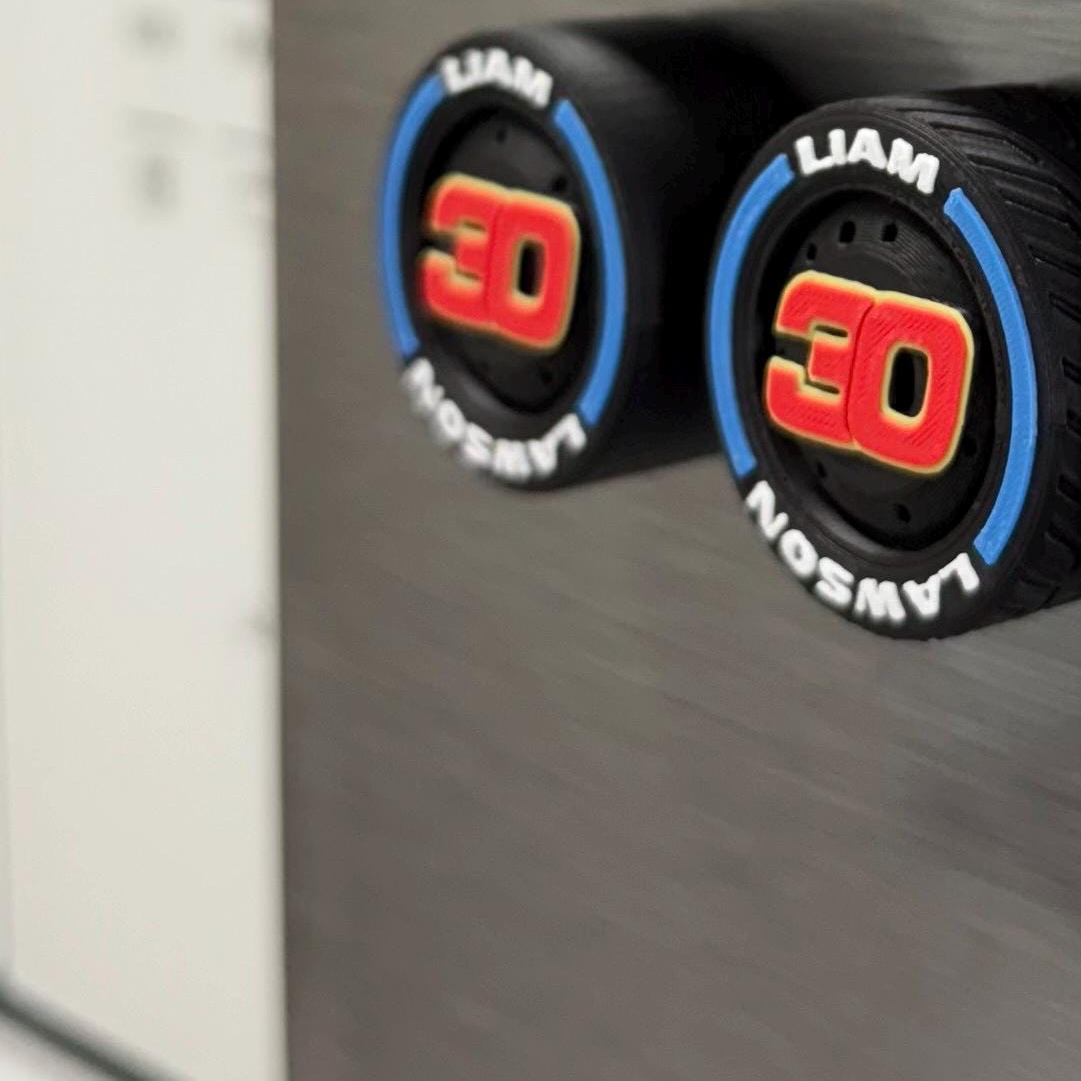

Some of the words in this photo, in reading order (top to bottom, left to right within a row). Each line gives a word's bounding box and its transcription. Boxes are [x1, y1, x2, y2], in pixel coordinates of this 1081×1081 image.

[441, 48, 553, 106] LIAM
[795, 127, 940, 194] LIAM
[418, 172, 581, 350] 30
[403, 357, 586, 477] LAWSON
[765, 269, 975, 475] 30
[745, 480, 980, 622] LAWSON
